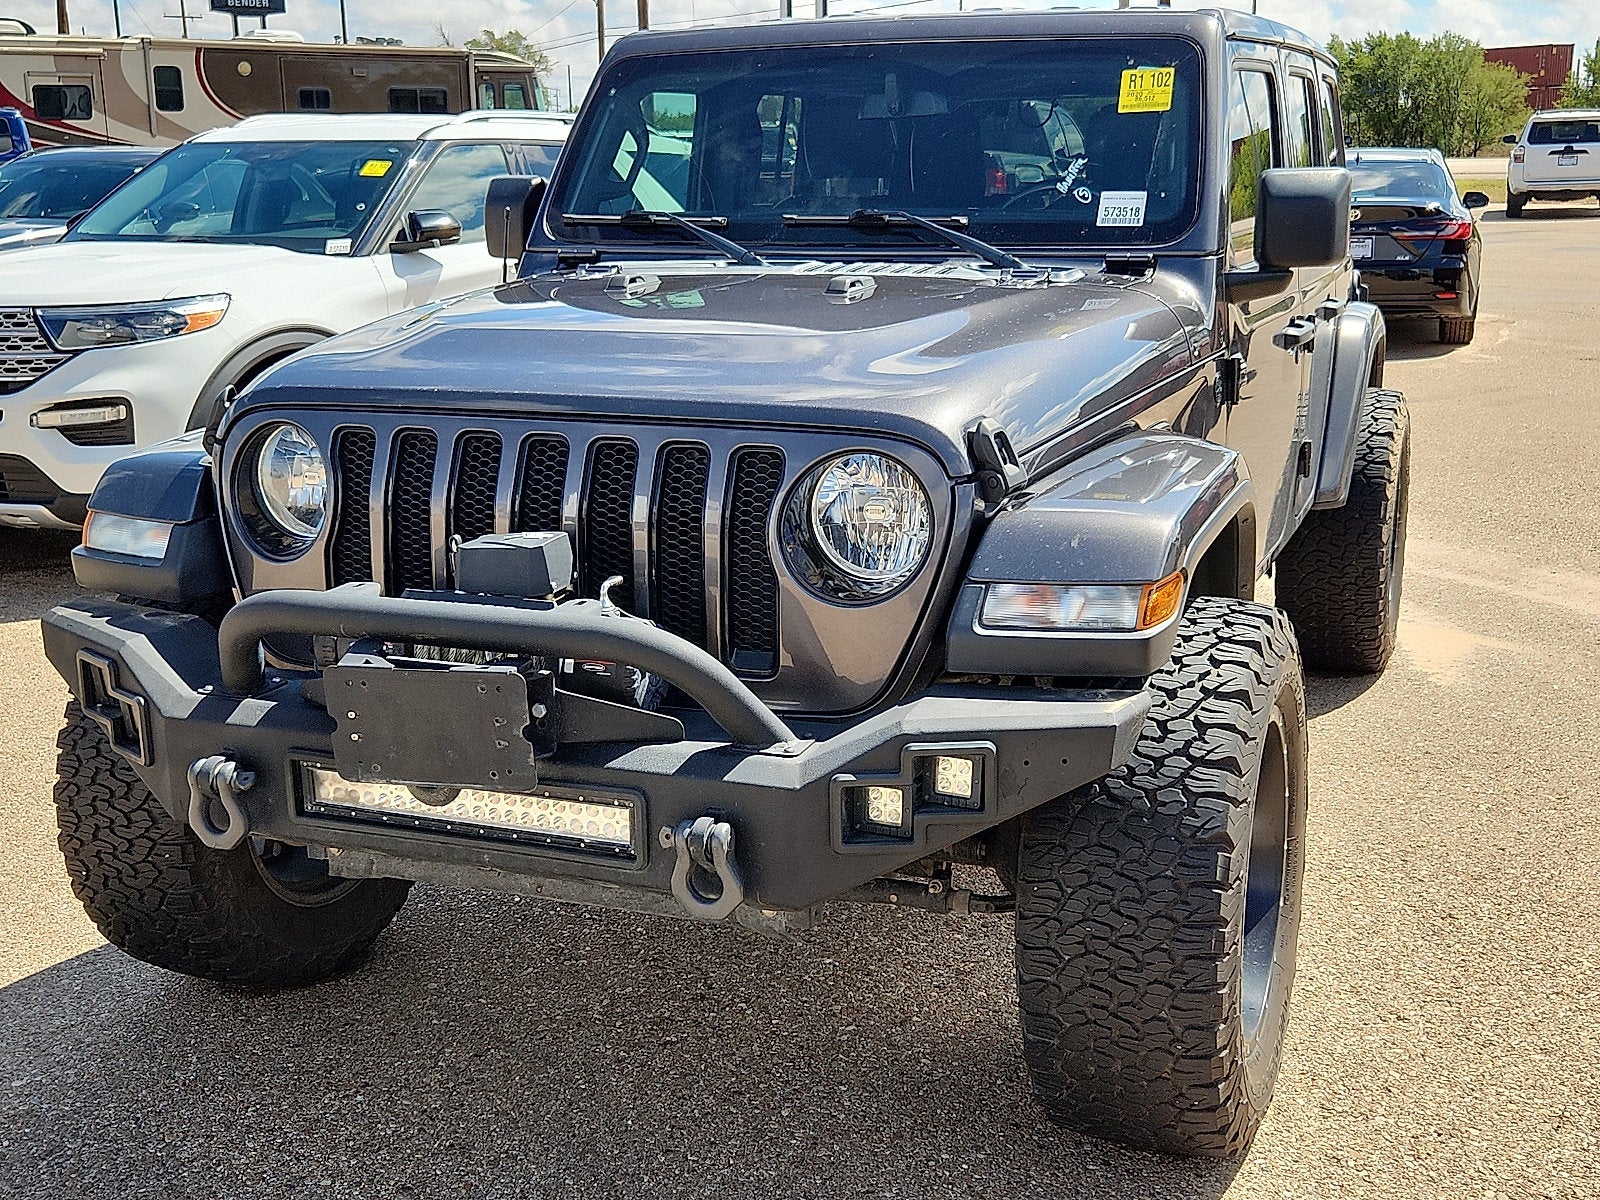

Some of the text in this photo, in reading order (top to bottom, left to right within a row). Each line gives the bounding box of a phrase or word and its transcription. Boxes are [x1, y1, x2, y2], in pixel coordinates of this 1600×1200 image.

[1129, 71, 1171, 89] R1 102
[1103, 206, 1140, 217] 573518
